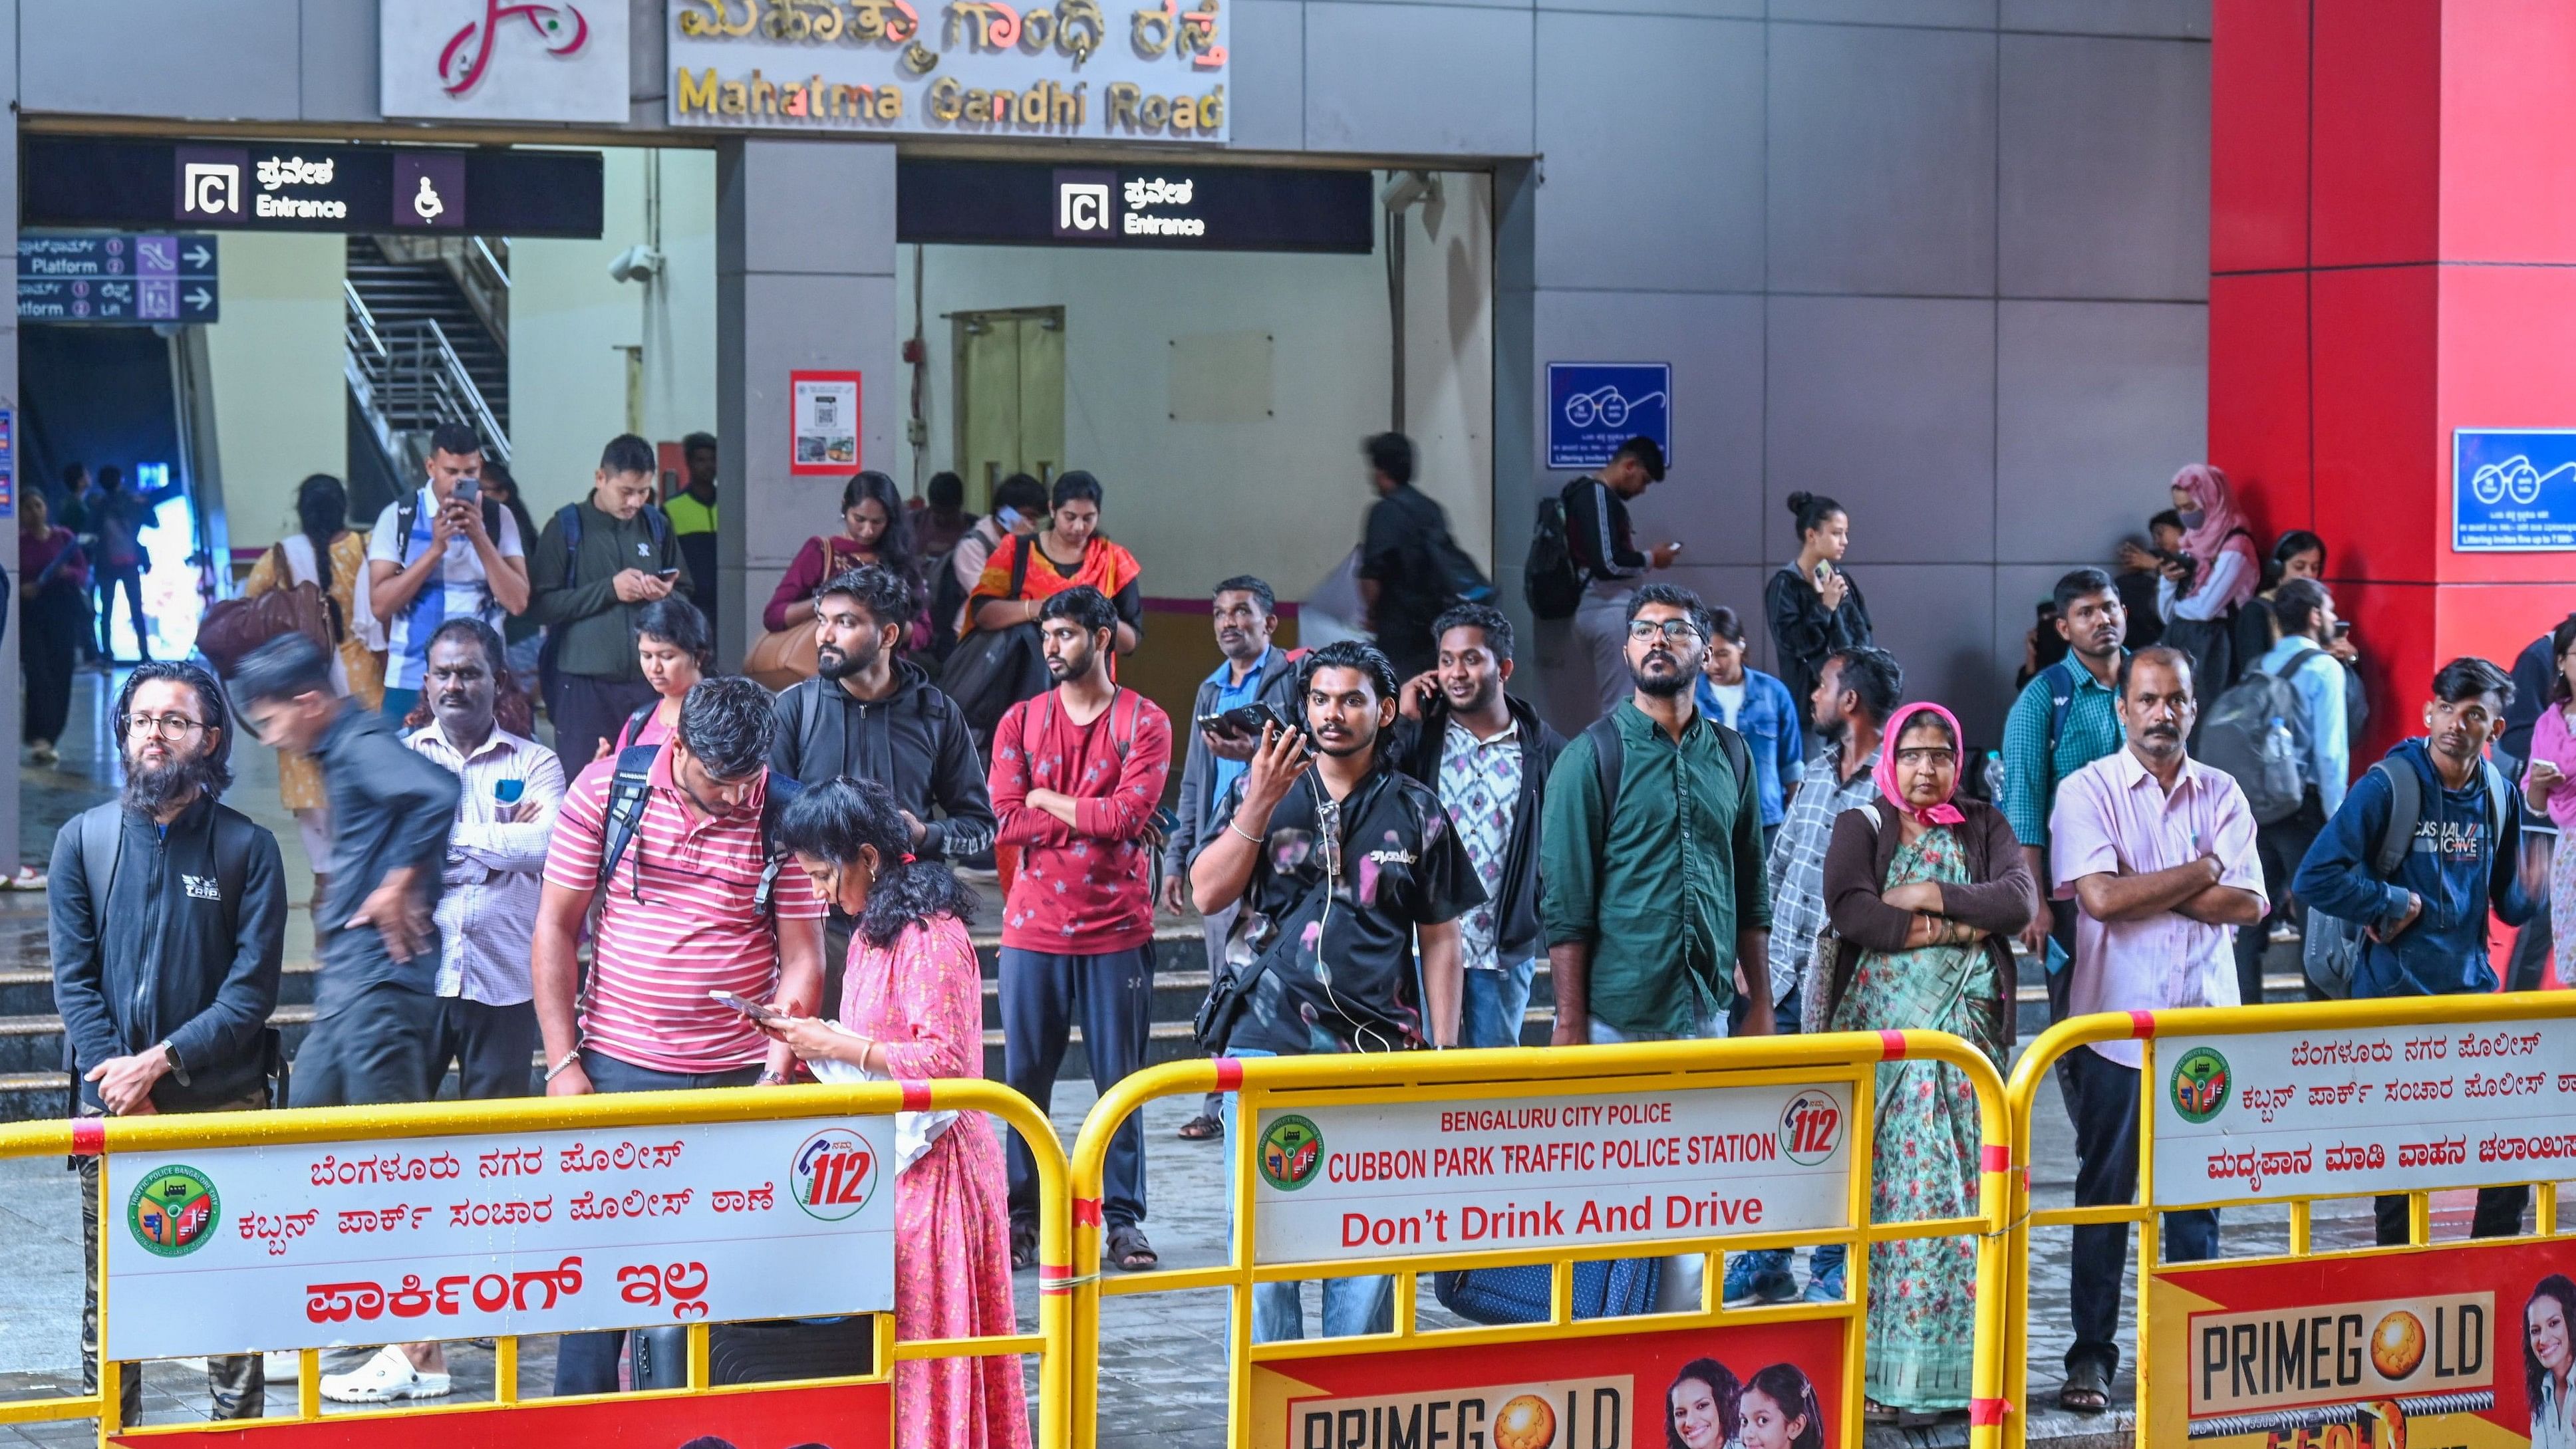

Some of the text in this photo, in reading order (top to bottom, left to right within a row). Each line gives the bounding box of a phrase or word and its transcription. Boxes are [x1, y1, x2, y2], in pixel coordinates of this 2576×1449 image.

[678, 67, 1225, 129] Mahatma Gandhi Road
[257, 156, 334, 190] ಪ್ರವೇಶ
[199, 176, 225, 213] C
[256, 194, 347, 219] Entrance
[1124, 177, 1193, 209] ಪ್ರವೇಶ
[1073, 194, 1097, 230] C
[1124, 212, 1205, 236] Entrance
[31, 257, 98, 274] Platform
[2292, 1033, 2541, 1066] ಬೆಂಗಳೂರು ನಗರ ಪೊಲೀಸ್
[2243, 1085, 2296, 1122] ಕಬ್ಬನ್
[2309, 1082, 2372, 1105] ಪಾರ್ಕ್
[2385, 1076, 2453, 1101] ಸಂಚಾರ
[2465, 1072, 2546, 1097] ಪೊಲೀಸ್
[1442, 1103, 1671, 1131] BENGALURU CITY POLICE
[1792, 1109, 1838, 1153] 112
[311, 1140, 684, 1186] ಬೆಂಗಳೂರು ನಗರ ಪೊಲೀಸ್
[1329, 1150, 1425, 1183] CUBBON
[1435, 1146, 1494, 1177] PARK
[1501, 1142, 1594, 1174] TRAFFIC
[1603, 1138, 1680, 1169] POLICE
[1687, 1133, 1775, 1164] STATION
[2208, 1143, 2312, 1192] ಮದ್ಯಪಾನ
[2326, 1141, 2384, 1171] ಮಾಡಿ
[2399, 1135, 2466, 1167] ವಾಹನ
[801, 1178, 813, 1204] Namma
[809, 1152, 870, 1205] 112
[239, 1182, 774, 1255] ಕಬ್ಬನ್ ಪಾರ್ಕ್ ಸಂಚಾರ ಪೊಲೀಸ್ ಠಾಣೆ
[1342, 1192, 1762, 1247] Don’t Drink And Drive
[307, 1255, 709, 1323] ಪಾರ್ಕಿಂಗ್ ಇಲ್ಲ
[2250, 1418, 2277, 1429] 550D
